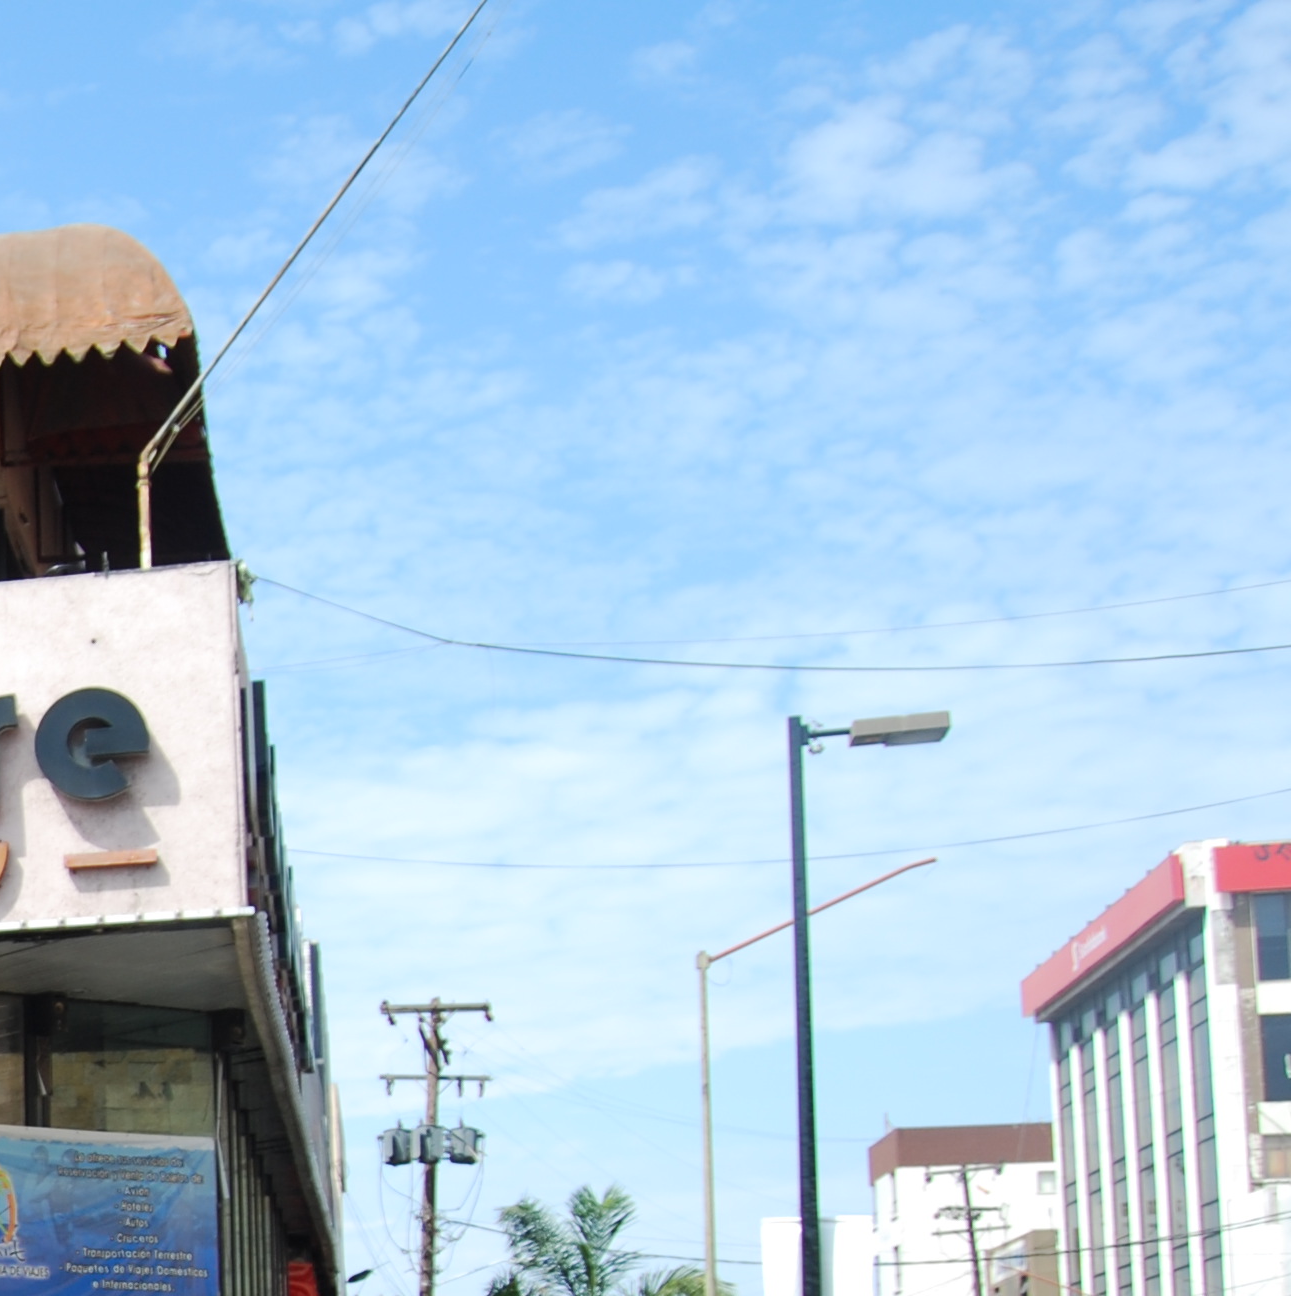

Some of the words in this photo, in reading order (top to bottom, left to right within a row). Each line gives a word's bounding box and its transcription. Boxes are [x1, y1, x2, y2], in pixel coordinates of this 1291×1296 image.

[121, 1201, 153, 1213] Hoteles
[125, 1217, 149, 1228] Autos
[116, 1233, 159, 1244] Cruceros
[154, 1249, 193, 1262] Terrestre
[9, 1265, 21, 1276] DE
[23, 1266, 50, 1278] VIAJES
[66, 1262, 110, 1275] Paquetes
[113, 1264, 125, 1274] de
[128, 1264, 154, 1277] Viajes
